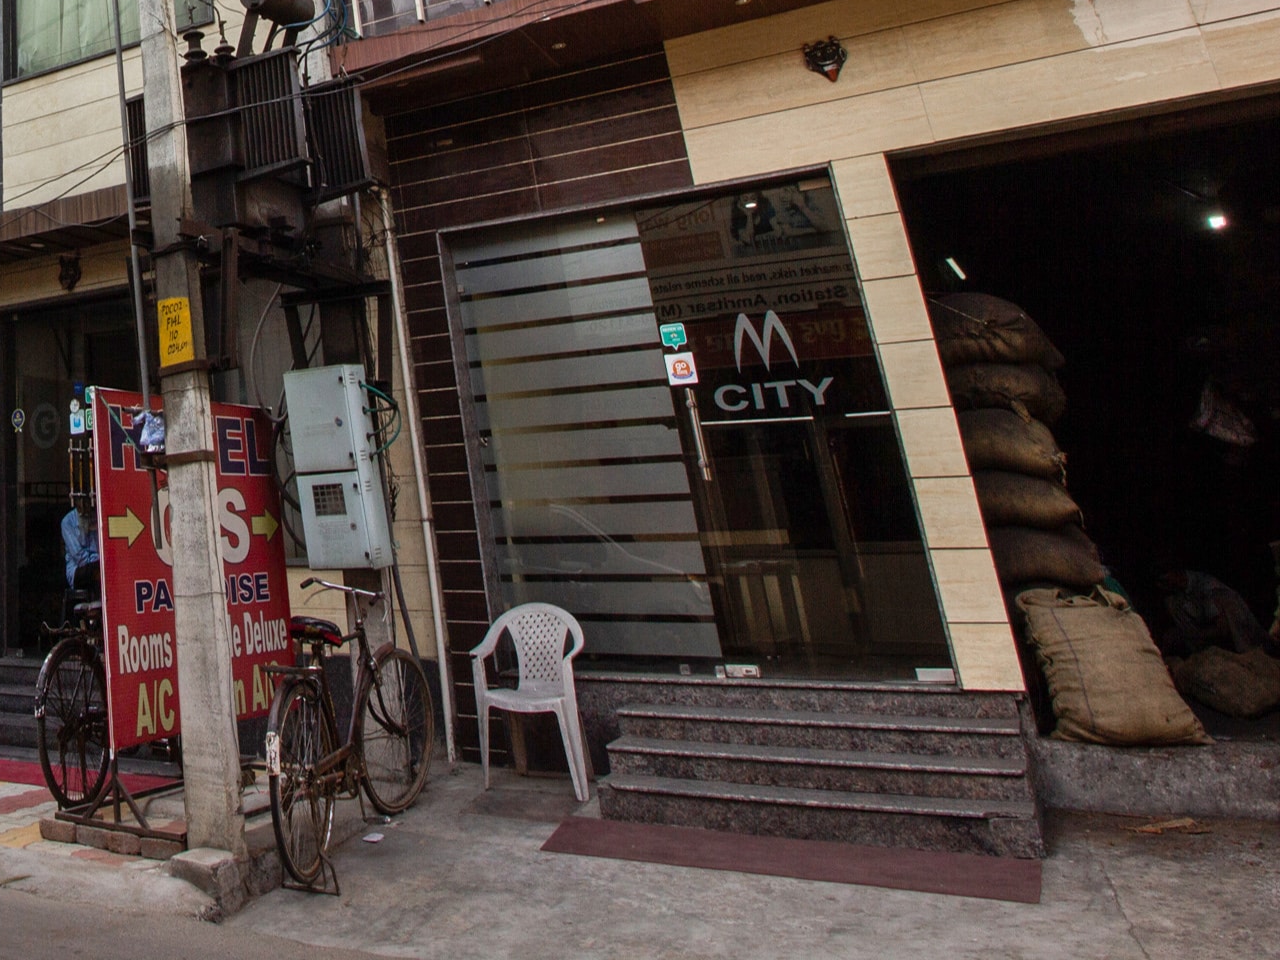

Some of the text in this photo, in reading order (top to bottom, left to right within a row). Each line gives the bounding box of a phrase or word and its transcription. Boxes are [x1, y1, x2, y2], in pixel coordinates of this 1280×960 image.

[713, 376, 835, 412] CITY
[108, 404, 272, 477] HEL
[134, 572, 271, 614] PAISE
[117, 624, 173, 675] Rooms
[243, 610, 288, 656] Deluxe
[136, 678, 175, 737] A/C
